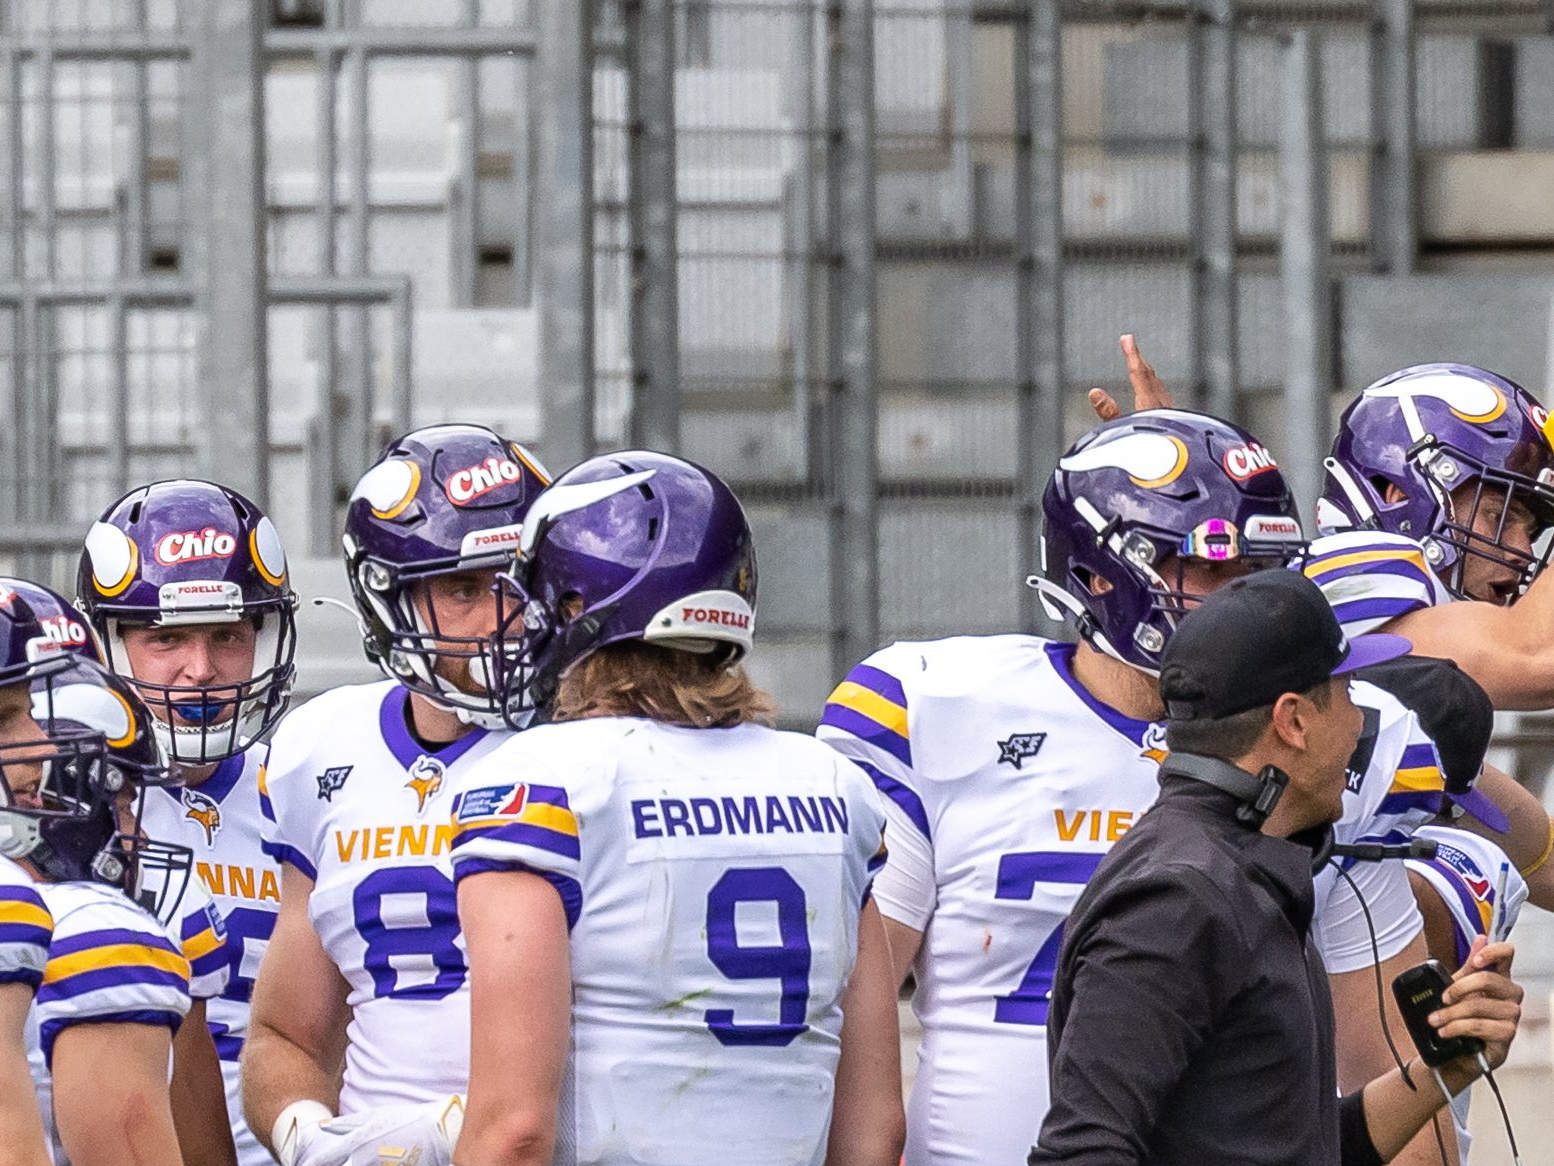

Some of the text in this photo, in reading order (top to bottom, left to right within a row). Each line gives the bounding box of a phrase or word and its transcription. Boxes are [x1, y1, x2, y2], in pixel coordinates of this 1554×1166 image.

[447, 457, 520, 504] Chio
[155, 528, 237, 566] Chio
[474, 531, 521, 546] FORELL
[178, 585, 223, 594] FORELLE
[39, 616, 87, 646] hio
[632, 795, 850, 841] ERDMANN
[1053, 809, 1136, 842] VIE
[335, 824, 453, 864] VIENN
[705, 867, 813, 1047] 9
